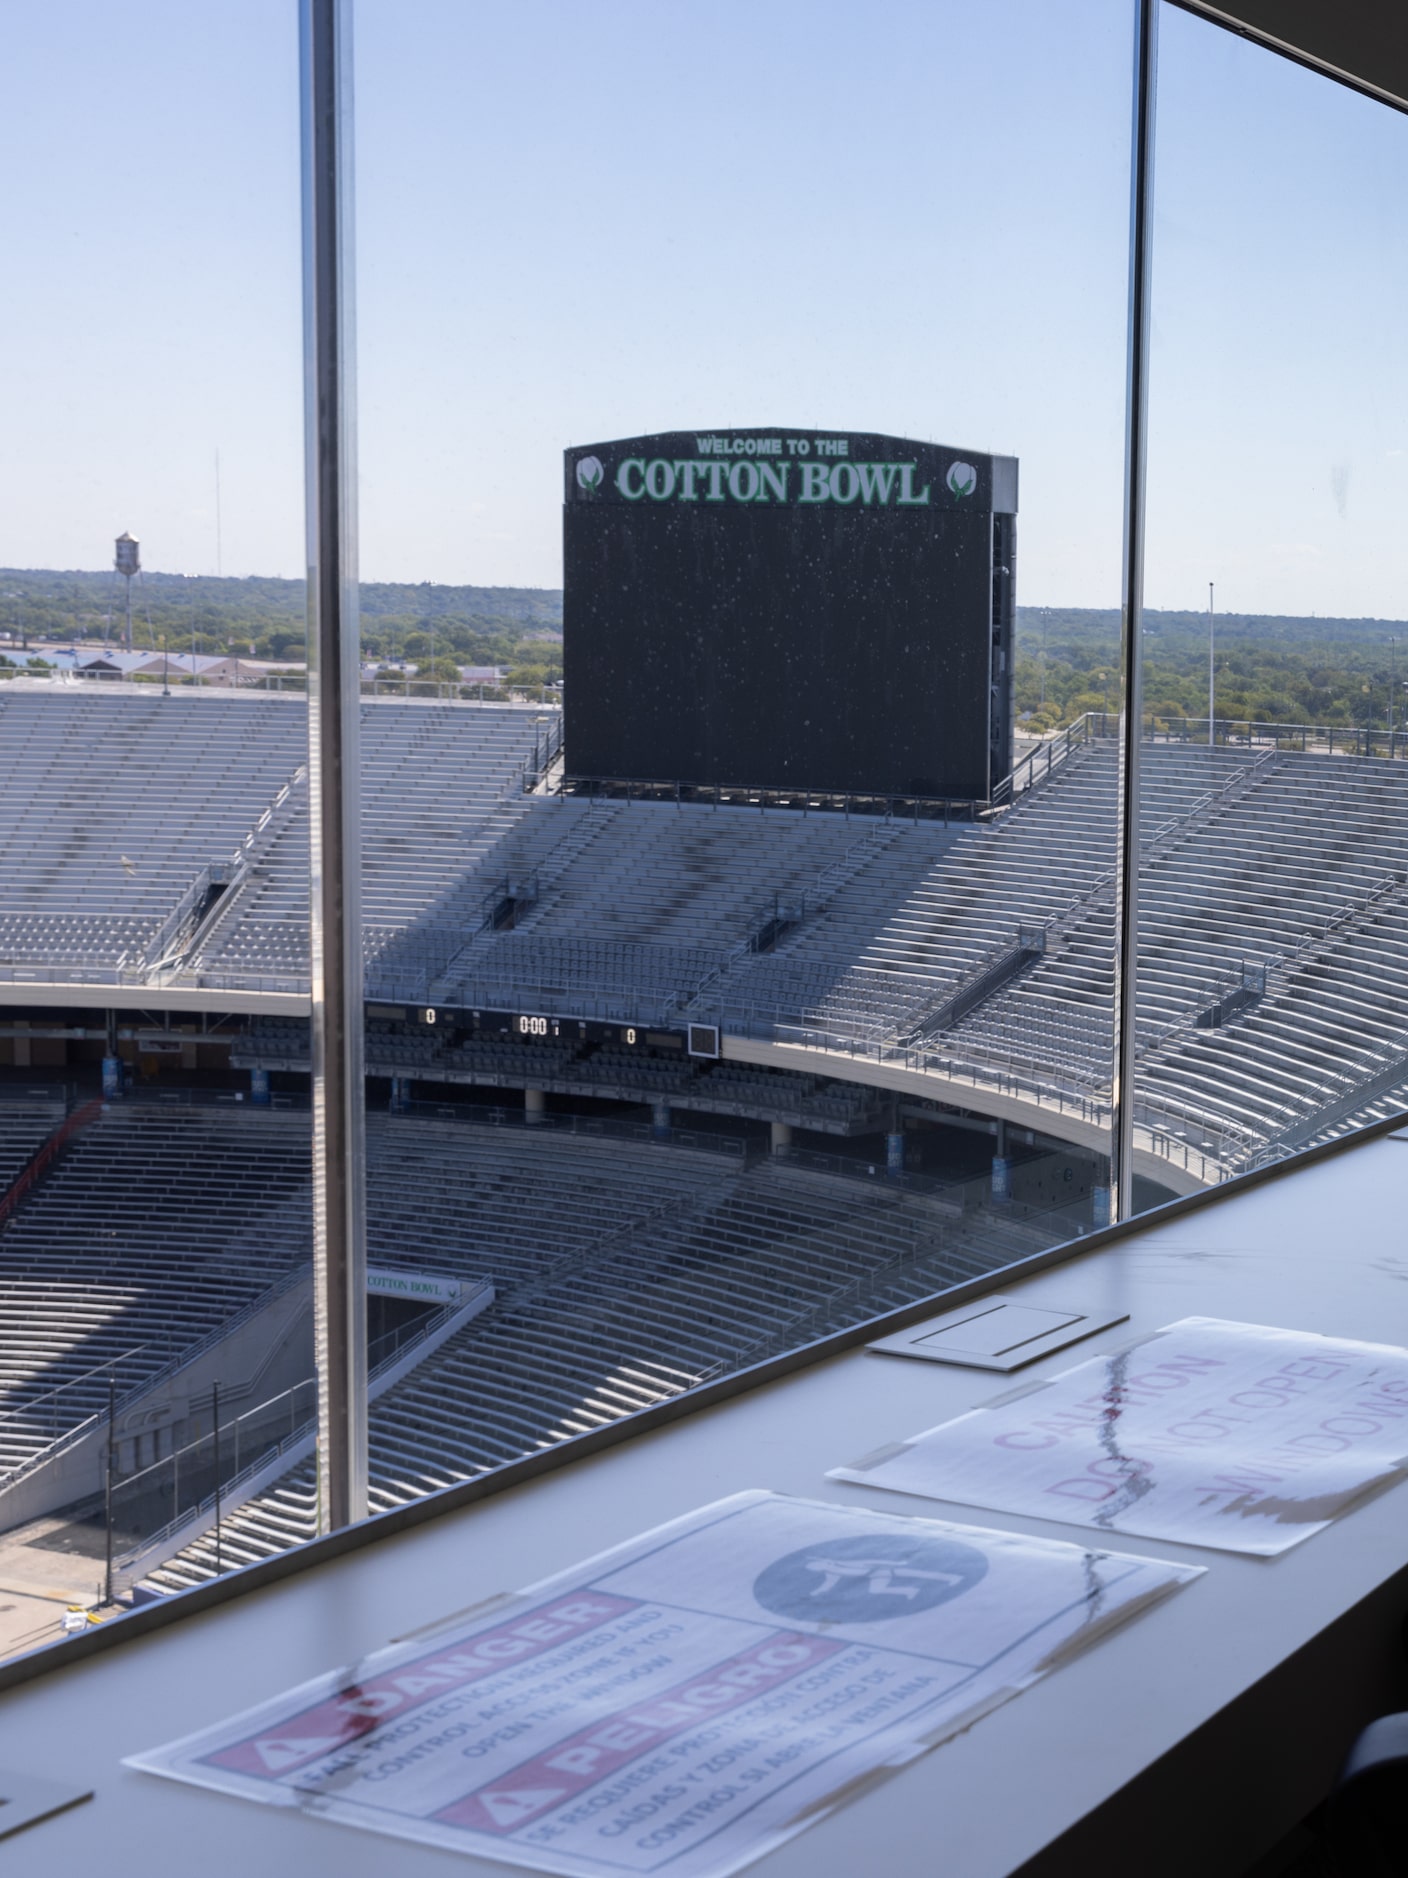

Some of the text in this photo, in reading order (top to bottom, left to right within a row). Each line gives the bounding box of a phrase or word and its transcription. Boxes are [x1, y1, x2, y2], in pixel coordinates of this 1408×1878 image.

[617, 457, 931, 506] COTTON BOWL
[697, 438, 849, 456] WELCOME TO THE
[426, 1009, 436, 1024] 0
[520, 1016, 547, 1036] 0:00
[627, 1029, 636, 1044] 0
[368, 1276, 441, 1295] COTTON BOWL
[993, 1354, 1228, 1451] CAUTION
[1044, 1348, 1367, 1503] DO NOT OPEN
[338, 1601, 613, 1717] DANGER
[362, 1624, 685, 1782] CONTROL ACCESS ZONE IF YOU
[364, 1677, 510, 1750] PROTECTION
[508, 1631, 617, 1680] REQUIRED
[619, 1610, 663, 1640] AND
[462, 1655, 674, 1758] OPEN THE WINDOW
[544, 1642, 816, 1776] PELIGRO
[526, 1816, 566, 1844] SE
[565, 1746, 677, 1832] REQUIERE
[796, 1649, 882, 1695] CONTRA
[598, 1781, 691, 1840] CAÍDAS
[696, 1737, 762, 1776] ZONA
[761, 1718, 795, 1740] DE
[791, 1684, 868, 1725] ACCESO
[859, 1666, 896, 1686] DE
[635, 1780, 750, 1852] CONTROL
[763, 1735, 824, 1770] ABRE
[816, 1723, 848, 1742] LA
[846, 1674, 940, 1726] VENTANA
